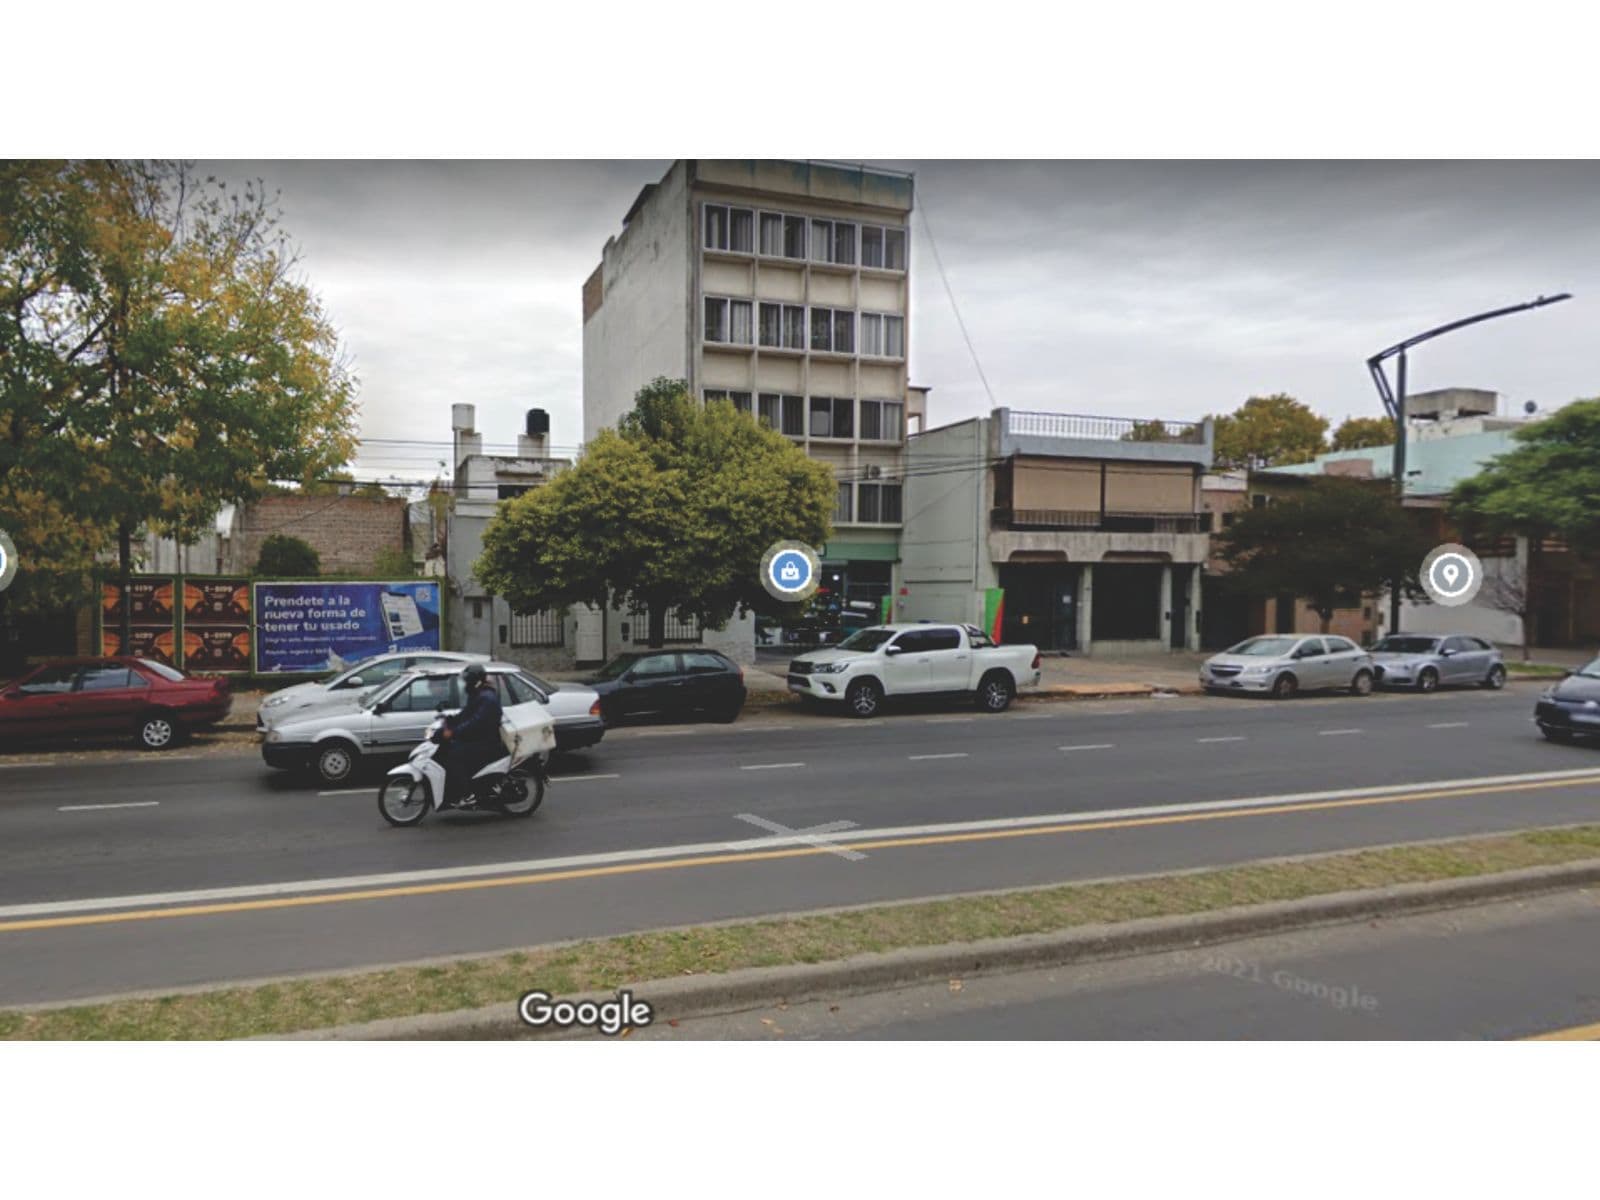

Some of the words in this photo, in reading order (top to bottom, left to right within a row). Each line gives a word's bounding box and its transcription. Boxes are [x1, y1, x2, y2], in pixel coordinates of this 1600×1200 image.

[264, 596, 325, 606] Prendete
[327, 597, 337, 606] a
[338, 595, 351, 606] la
[264, 610, 305, 620] nueva
[307, 608, 347, 619] forma
[349, 608, 367, 618] de
[264, 621, 299, 632] tener
[303, 621, 318, 631] tu
[320, 620, 360, 631] usado
